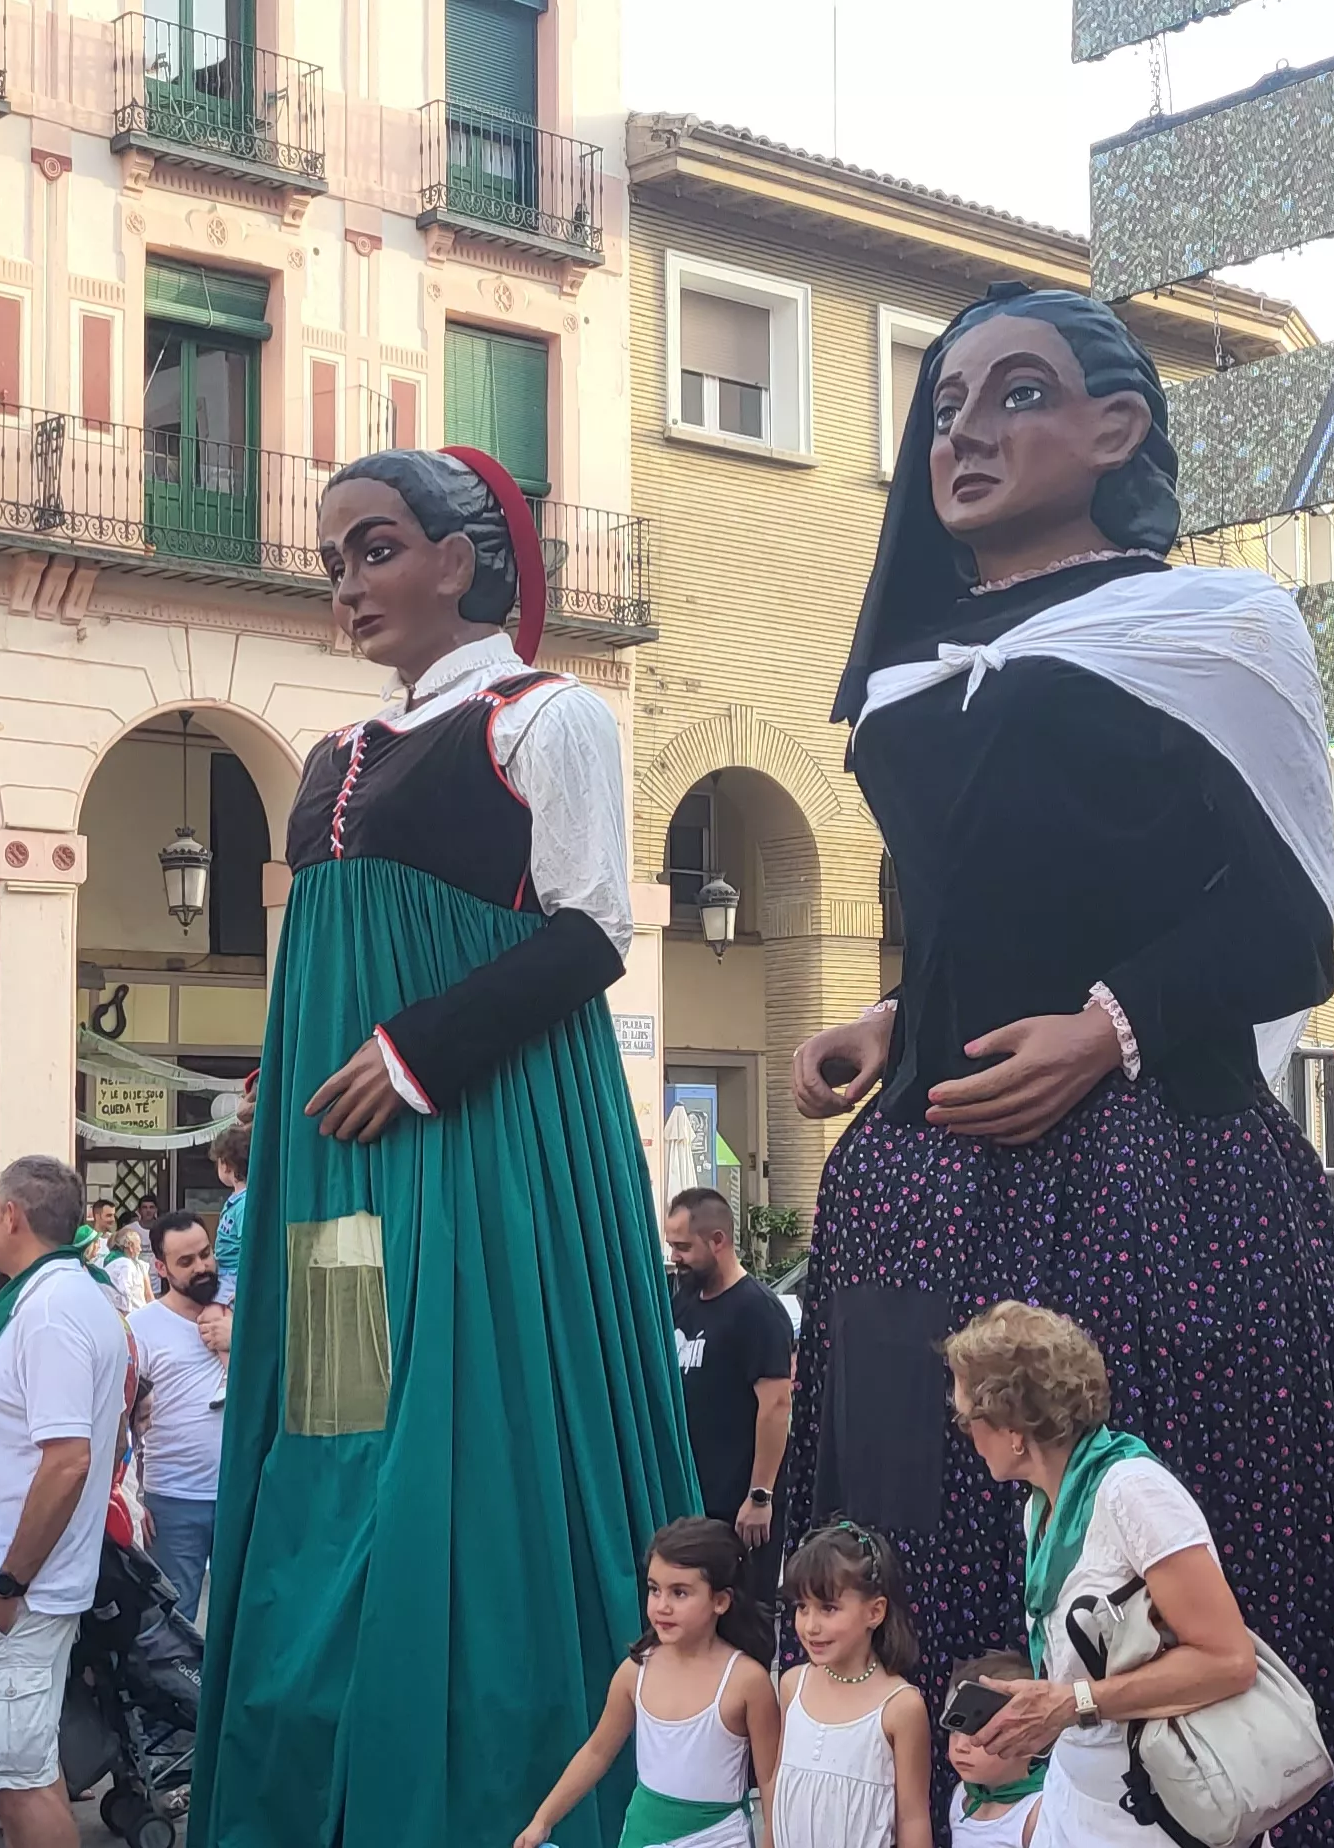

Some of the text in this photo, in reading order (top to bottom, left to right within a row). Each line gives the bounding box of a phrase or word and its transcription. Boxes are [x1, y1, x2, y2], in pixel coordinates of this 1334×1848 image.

[100, 1089, 107, 1100] Y
[110, 1089, 119, 1100] LE
[145, 1089, 164, 1100] SOLO
